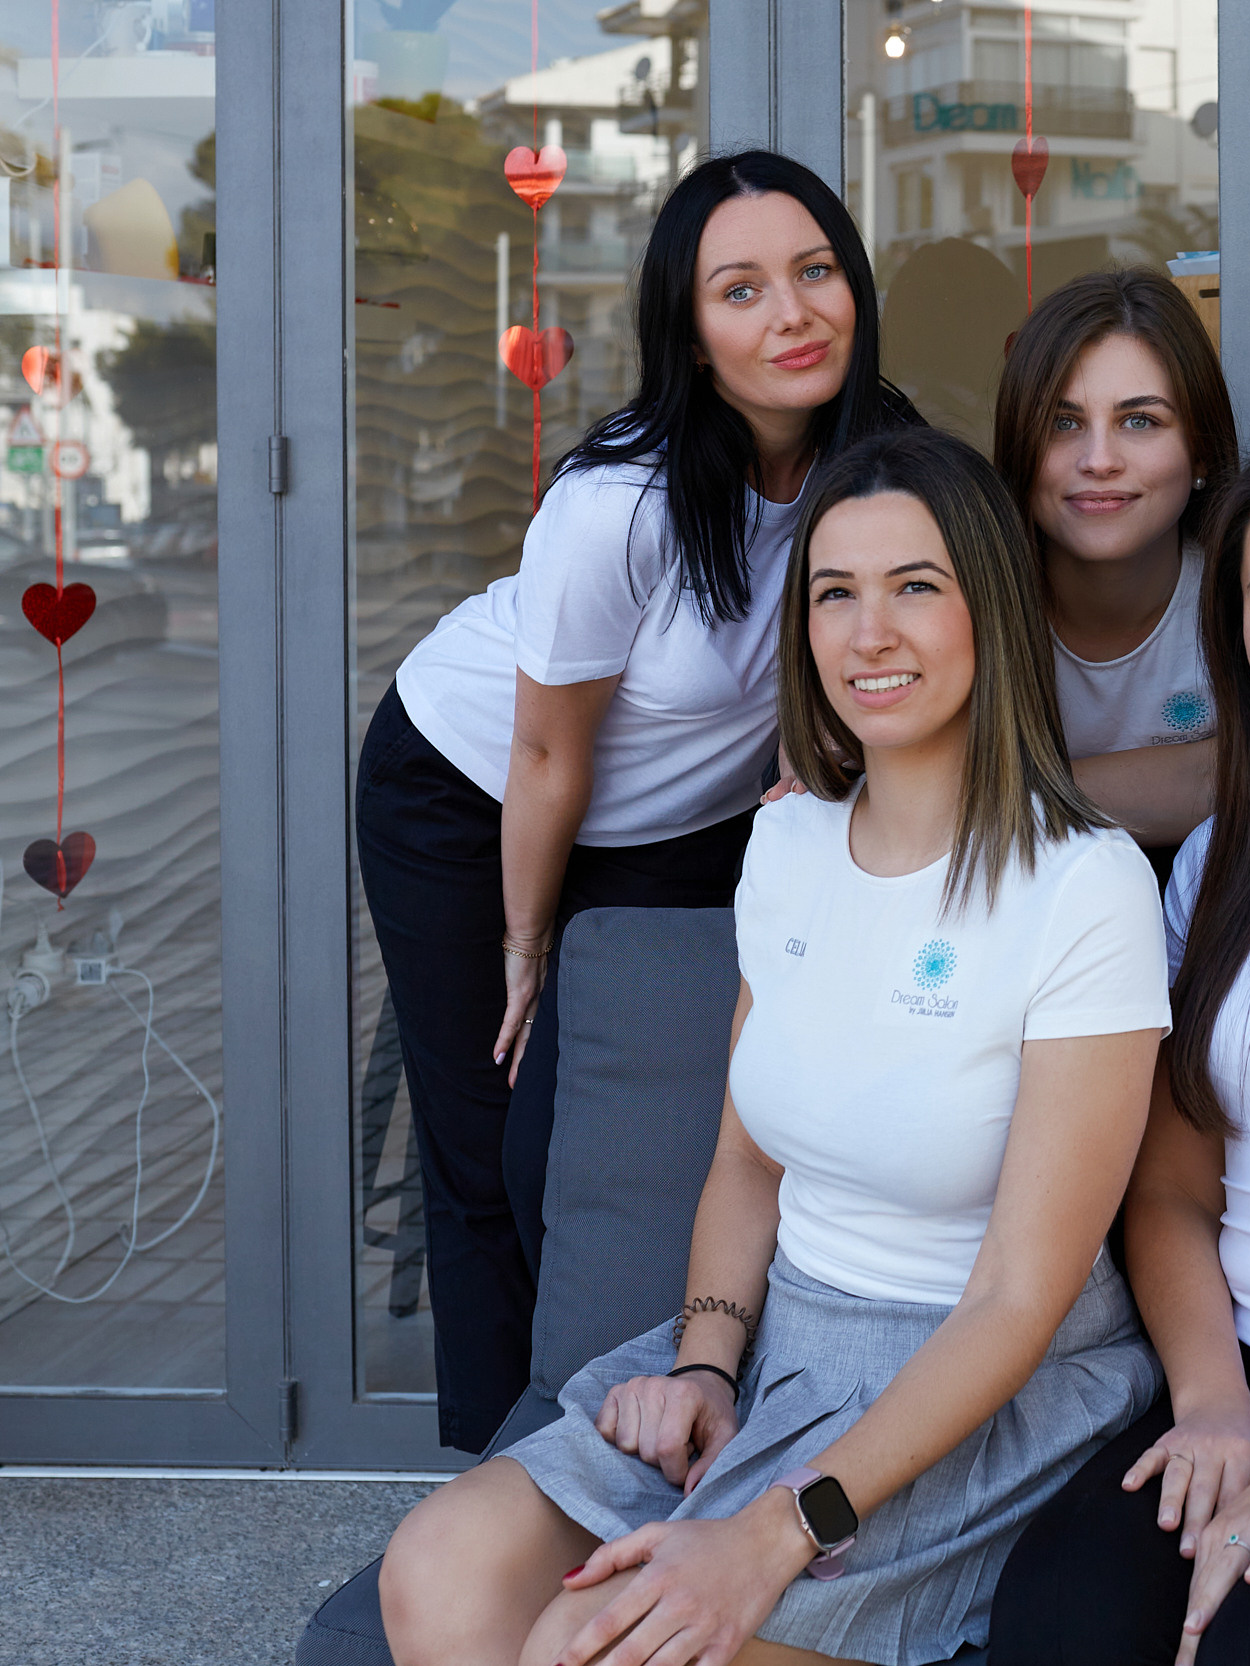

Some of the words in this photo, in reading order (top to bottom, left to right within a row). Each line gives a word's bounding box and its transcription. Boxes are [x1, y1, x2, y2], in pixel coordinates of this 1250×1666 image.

[1151, 734, 1188, 745] Dream
[890, 989, 925, 1006] Dream
[928, 993, 959, 1010] Salon
